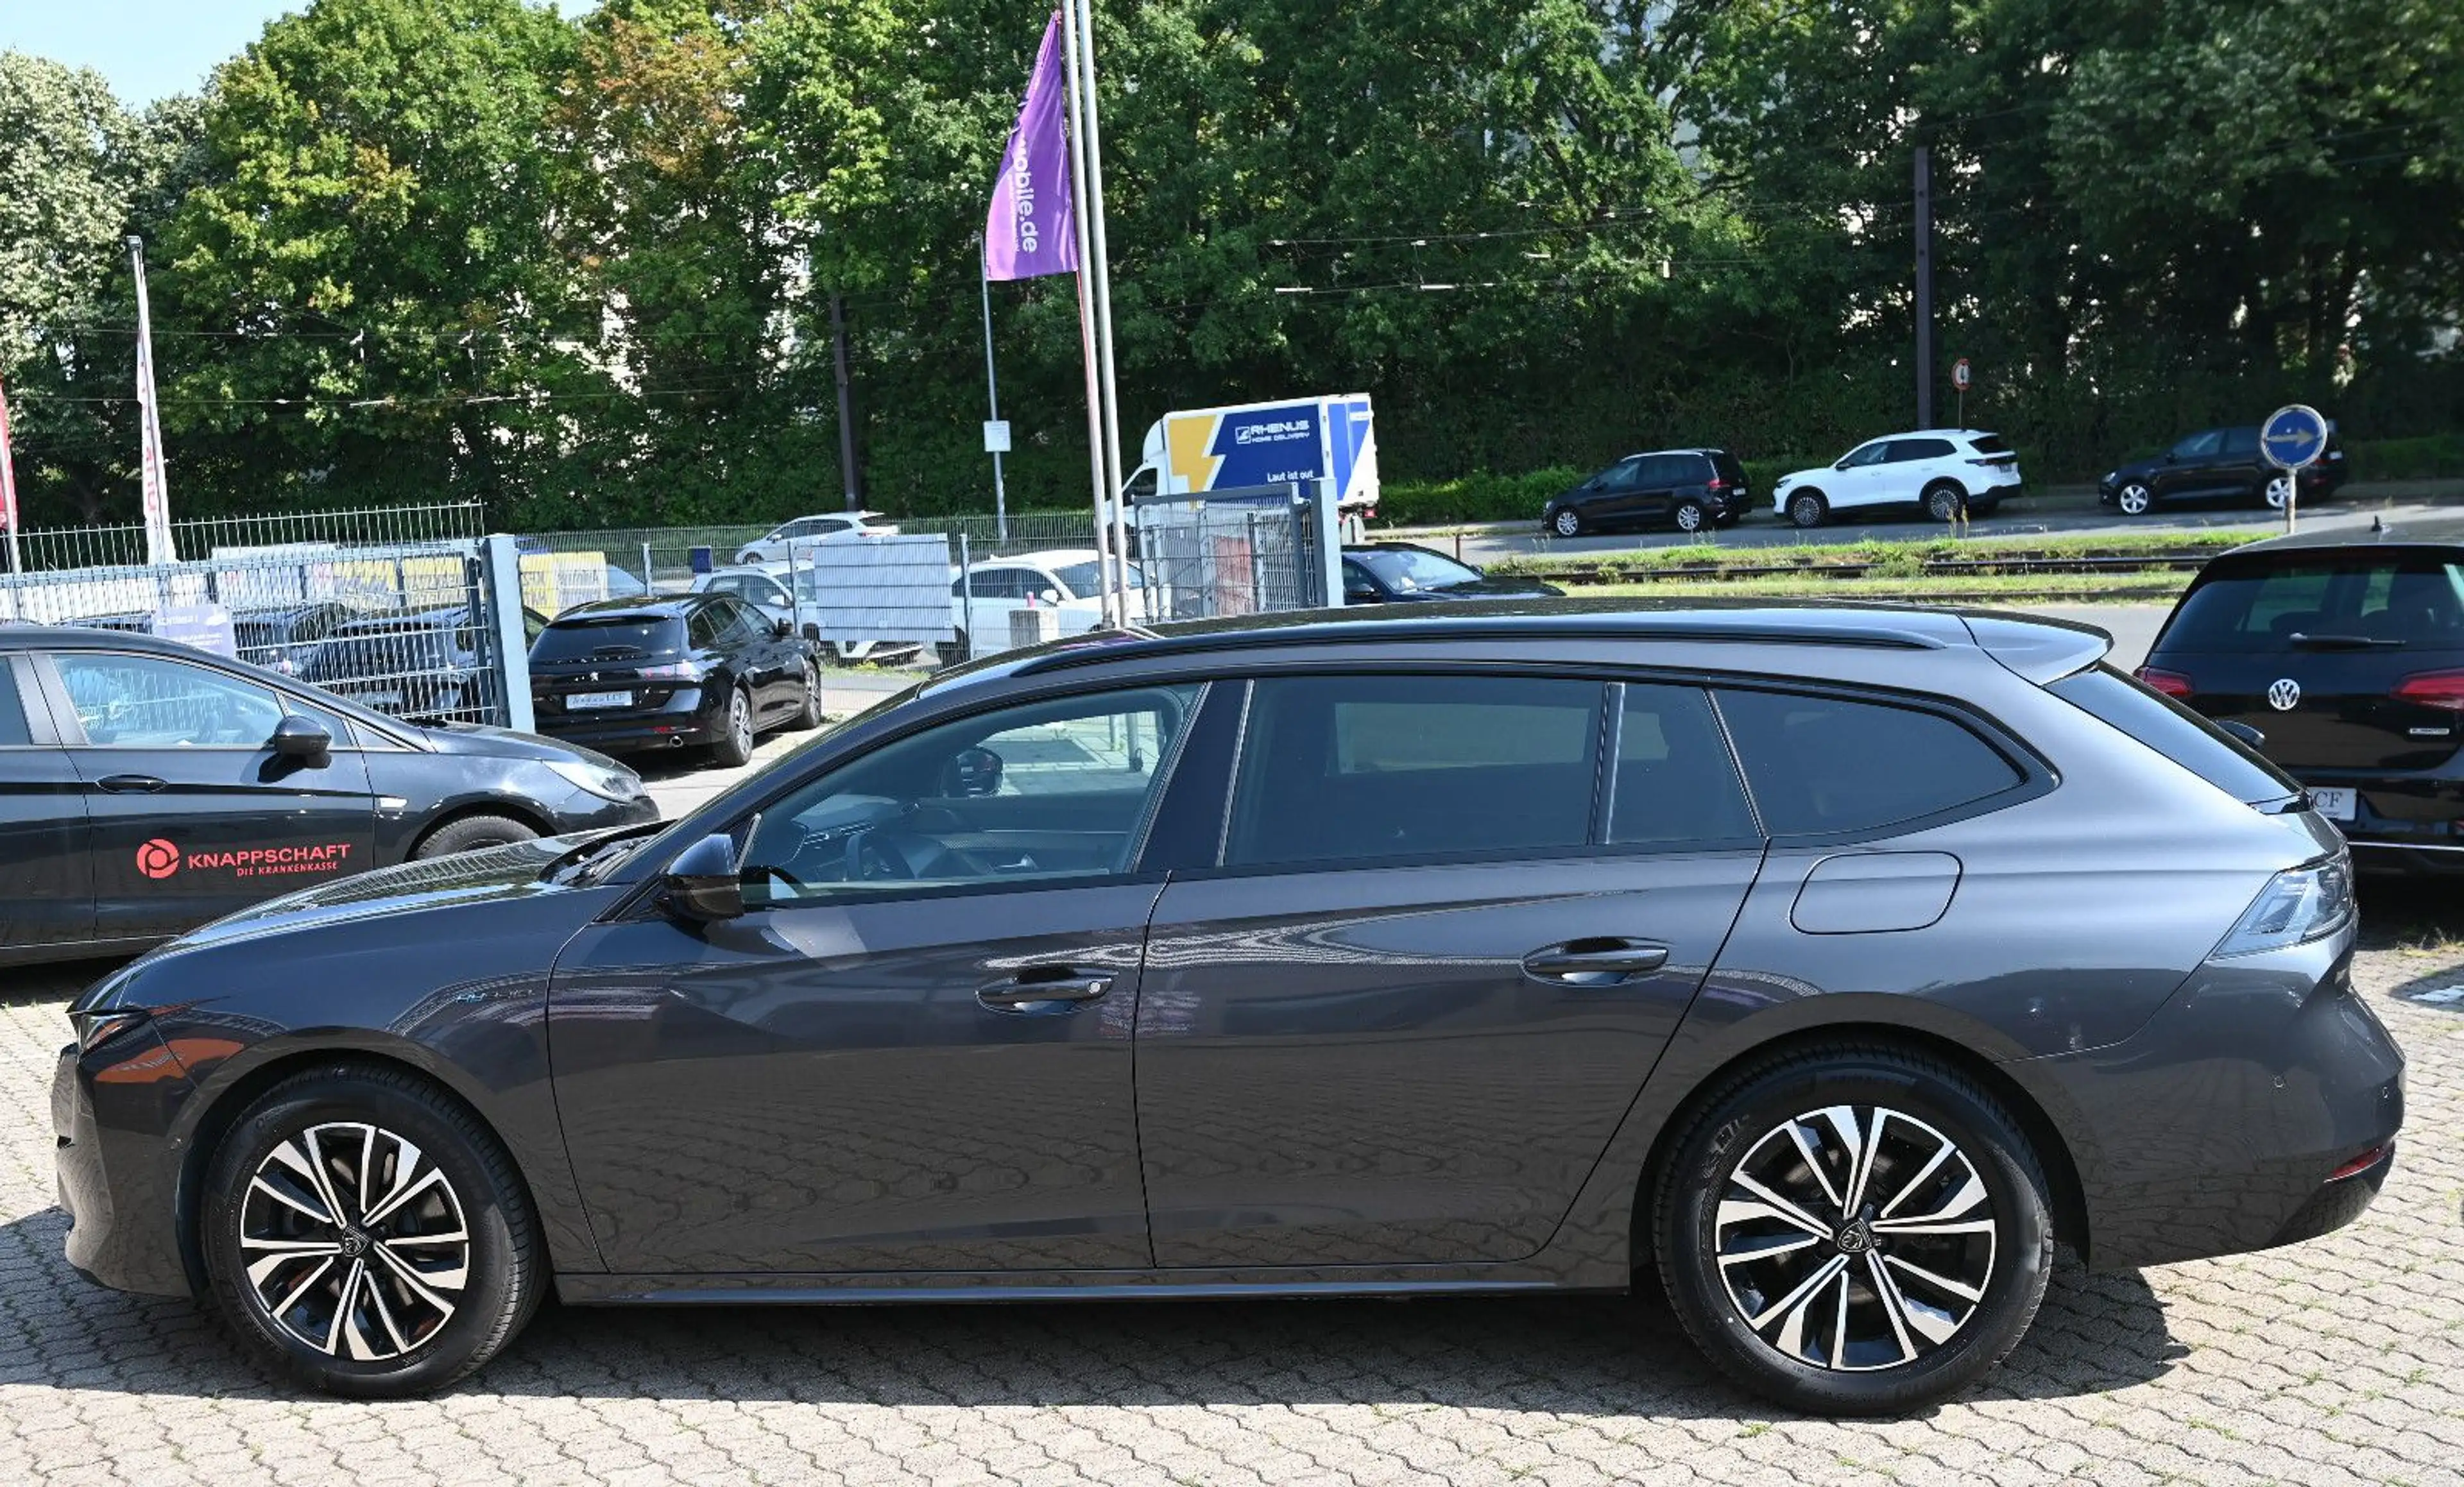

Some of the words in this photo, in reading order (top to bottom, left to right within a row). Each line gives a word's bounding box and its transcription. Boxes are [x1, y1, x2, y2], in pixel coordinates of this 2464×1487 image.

[1251, 420, 1310, 435] RHENUS
[1267, 472, 1287, 483] Laut
[1287, 471, 1299, 480] ist
[187, 844, 351, 869] KNAPPSCHAFT
[237, 866, 254, 877] DIE
[258, 861, 338, 875] KRANKENKASSE
